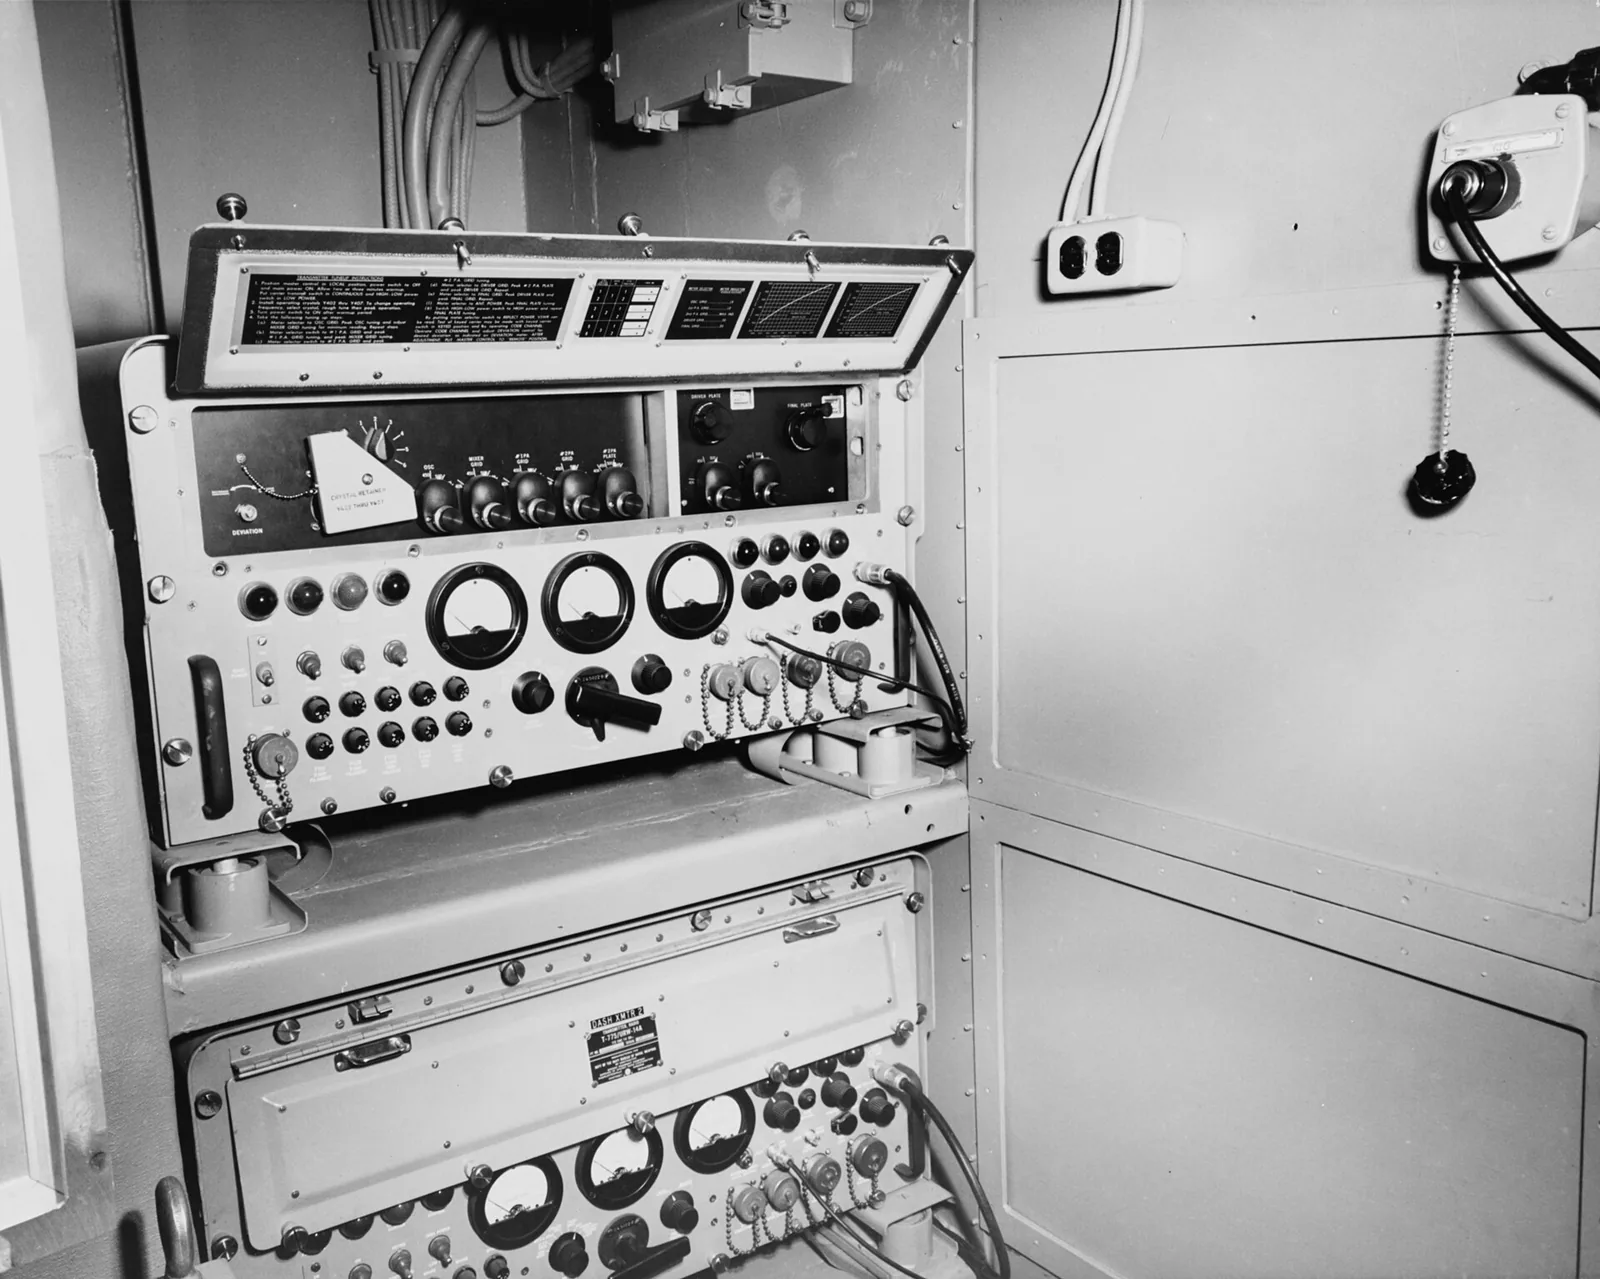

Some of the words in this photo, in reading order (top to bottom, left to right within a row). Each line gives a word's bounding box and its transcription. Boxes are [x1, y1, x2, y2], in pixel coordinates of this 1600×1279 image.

[232, 528, 263, 536] DEVIATION
[592, 1016, 613, 1029] DASH
[615, 1009, 636, 1022] XMTR
[637, 1007, 644, 1016] 2
